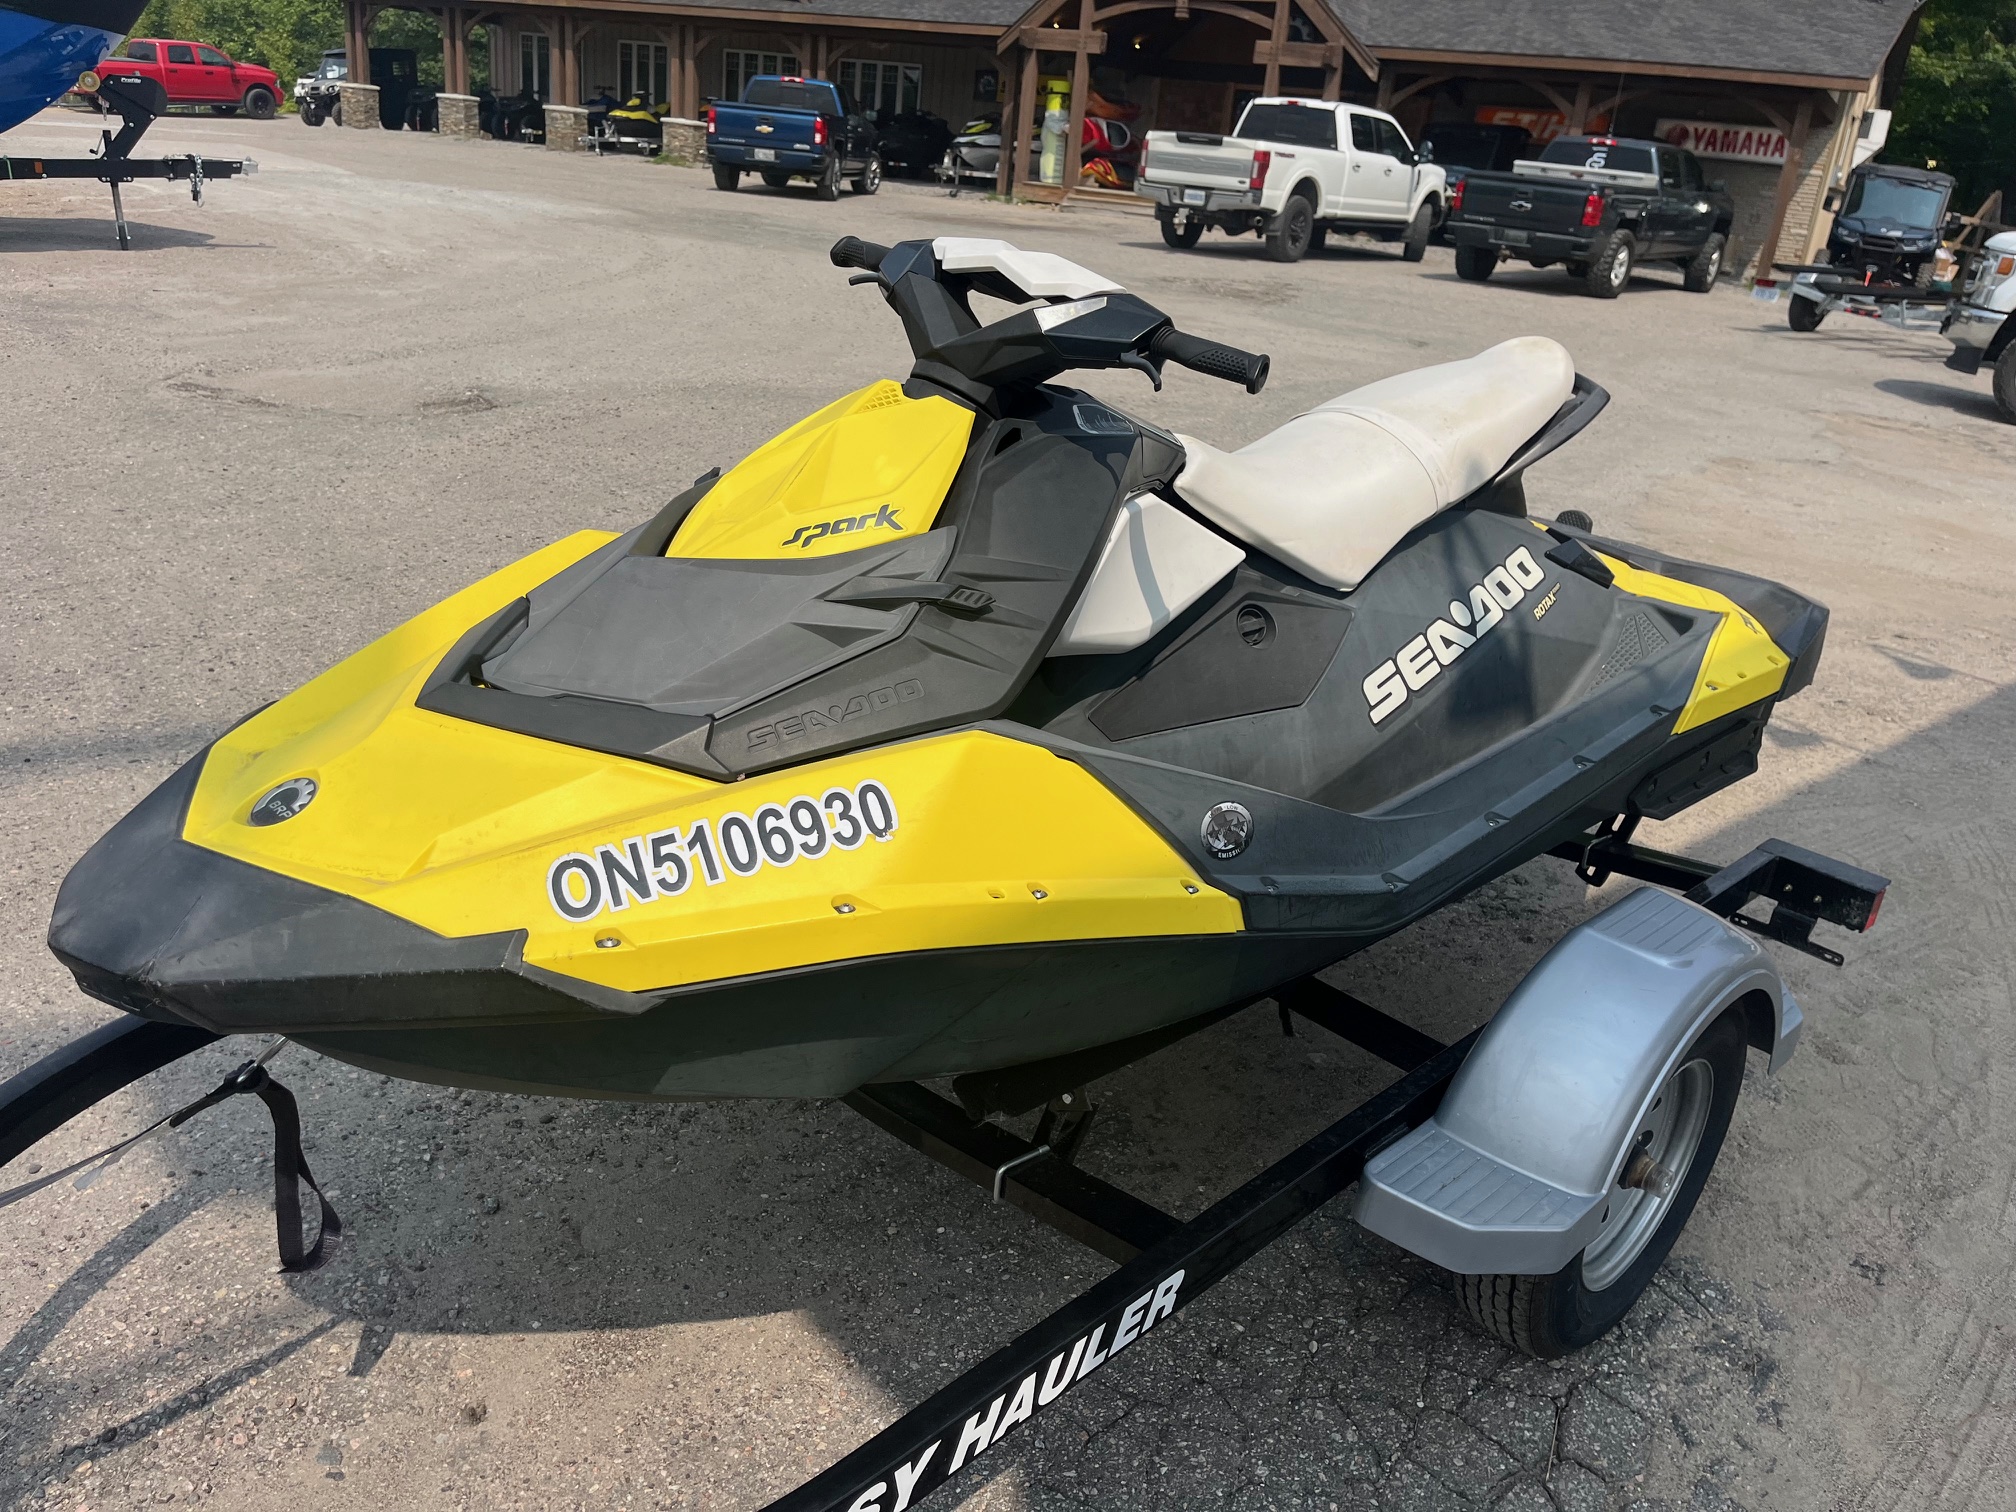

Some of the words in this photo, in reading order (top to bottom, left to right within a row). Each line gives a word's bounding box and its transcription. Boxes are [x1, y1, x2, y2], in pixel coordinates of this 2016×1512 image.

[1693, 126, 1786, 158] YAMAHA
[1533, 590, 1557, 621] ROTAX
[268, 800, 293, 818] BRP
[548, 780, 896, 920] ON5106930
[949, 1269, 1186, 1475] HAULER
